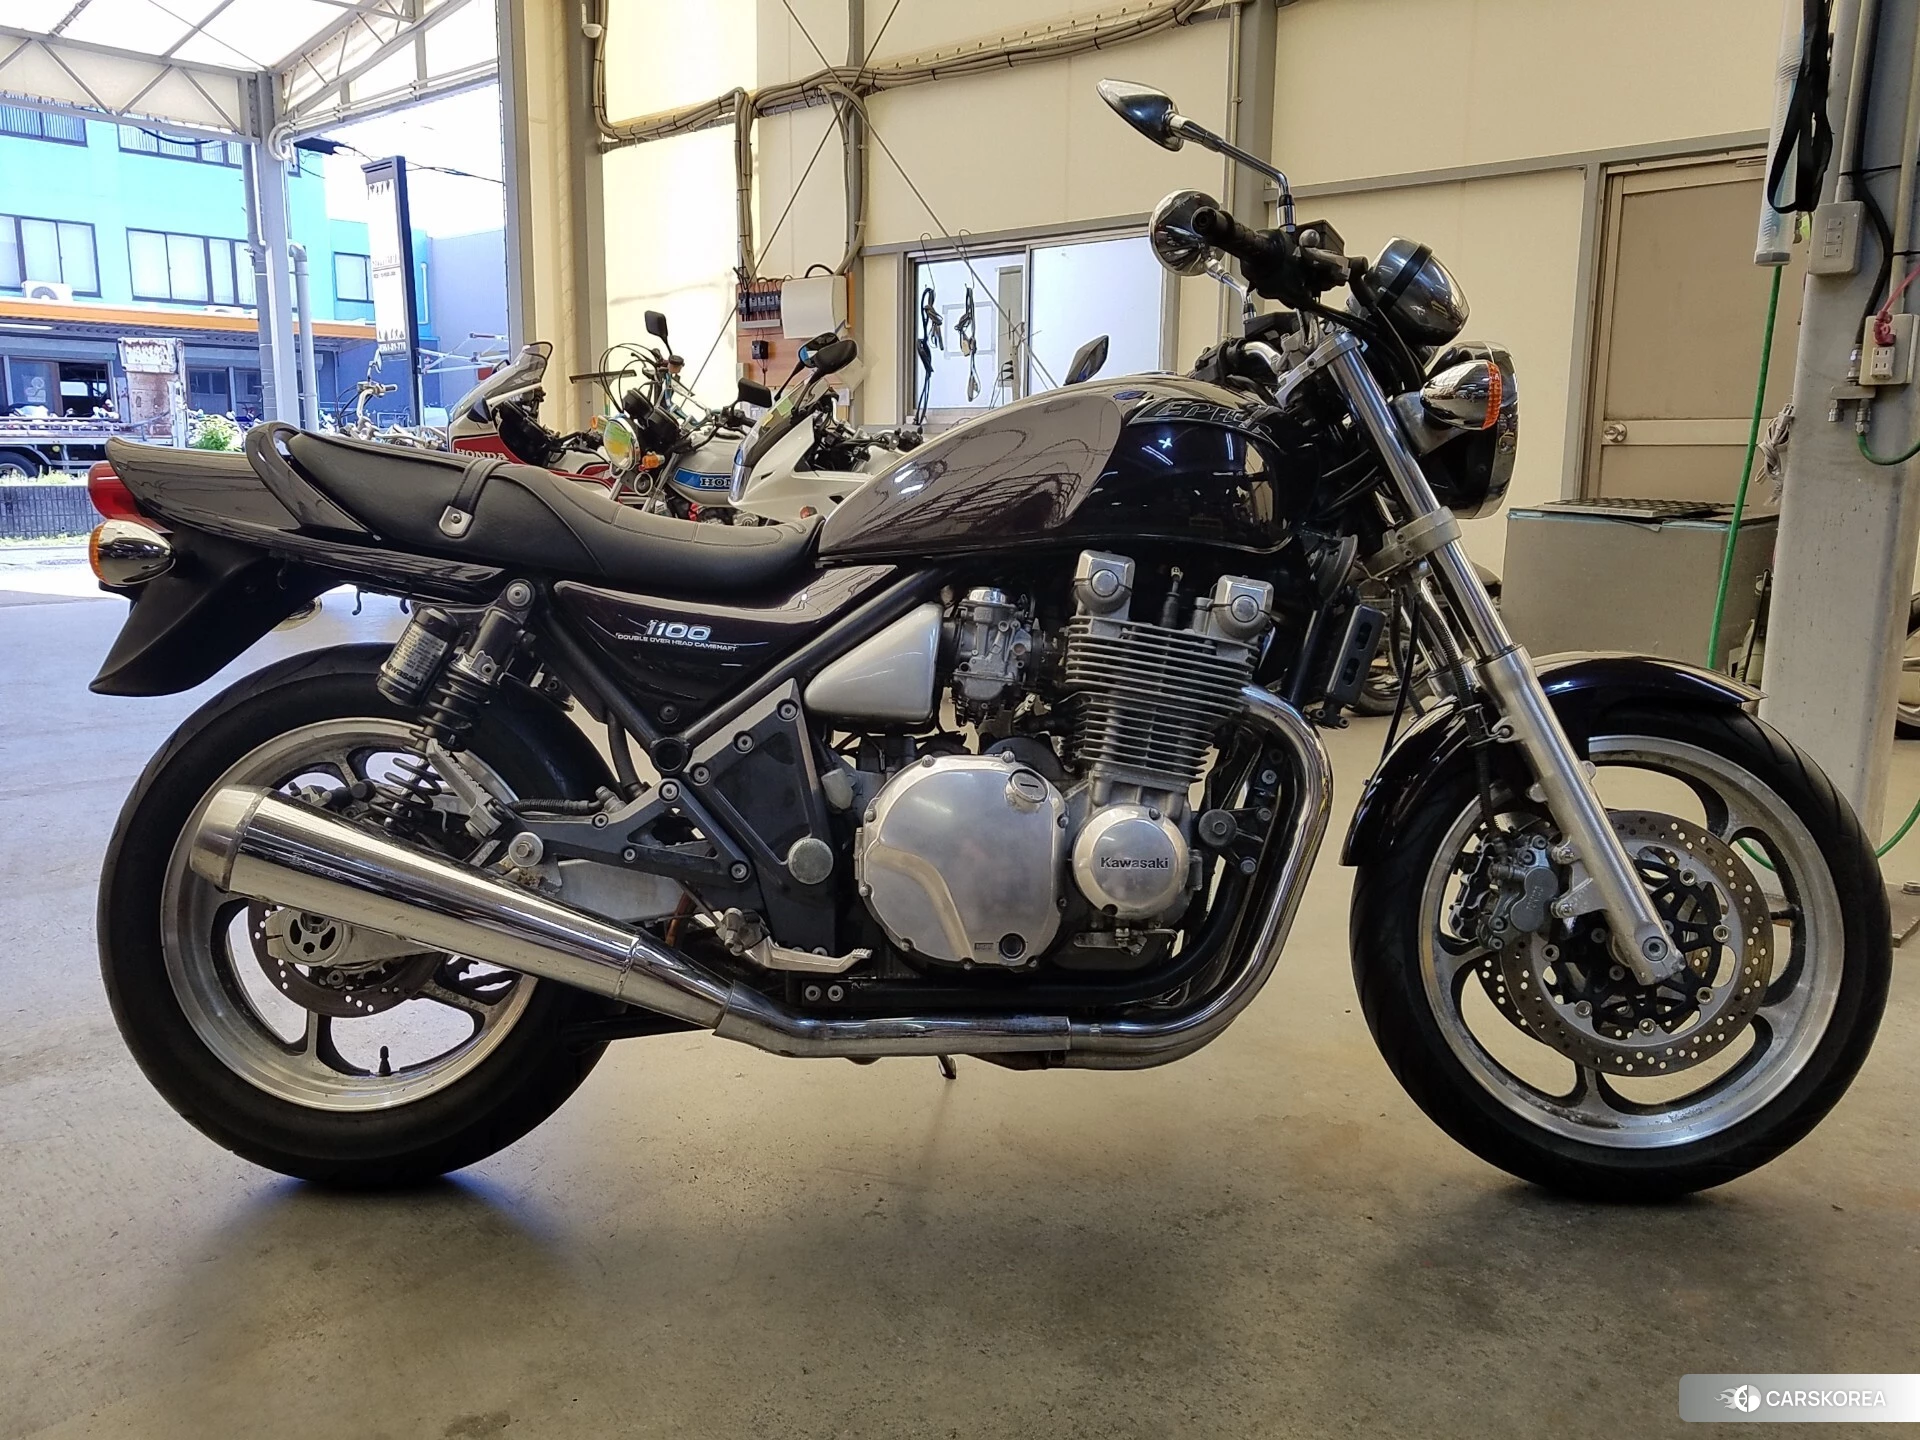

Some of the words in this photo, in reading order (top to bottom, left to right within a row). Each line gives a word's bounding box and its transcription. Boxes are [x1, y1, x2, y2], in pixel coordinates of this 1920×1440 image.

[455, 448, 509, 461] HONDA
[646, 619, 712, 641] 1100
[616, 633, 648, 642] DOUBLE
[649, 636, 671, 645] OVER
[672, 639, 693, 647] HEAD
[694, 642, 738, 652] CAMSHAFT
[1101, 857, 1169, 869] Kawasaki
